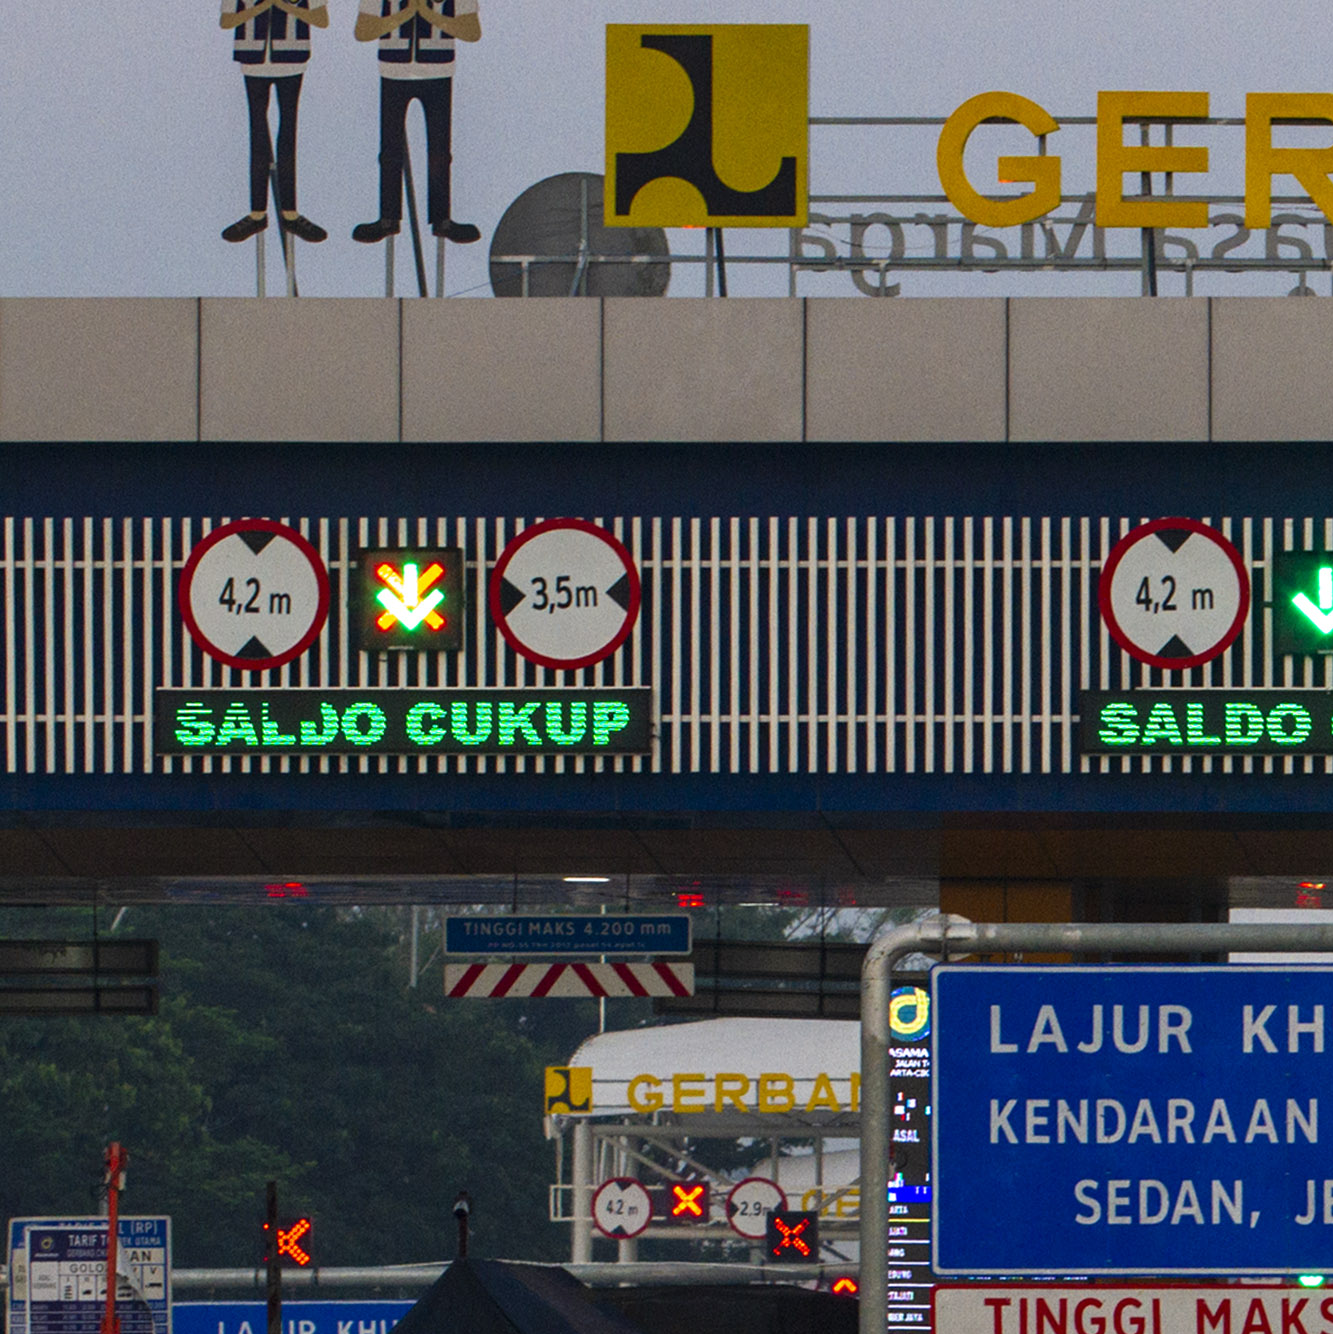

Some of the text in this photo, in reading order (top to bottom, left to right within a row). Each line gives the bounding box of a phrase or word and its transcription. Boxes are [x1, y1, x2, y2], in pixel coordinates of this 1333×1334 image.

[1135, 576, 1214, 613] 4,2 m
[406, 702, 630, 746] CUKUP
[1099, 703, 1312, 746] SALDO
[464, 922, 522, 935] TINGGI
[528, 922, 575, 935] MAKS
[641, 923, 672, 934] mm
[991, 1004, 1192, 1053] LAJUR
[990, 1098, 1318, 1144] KENDARAAN
[1074, 1179, 1260, 1228] SEDAN,
[69, 1234, 98, 1247] TARIF
